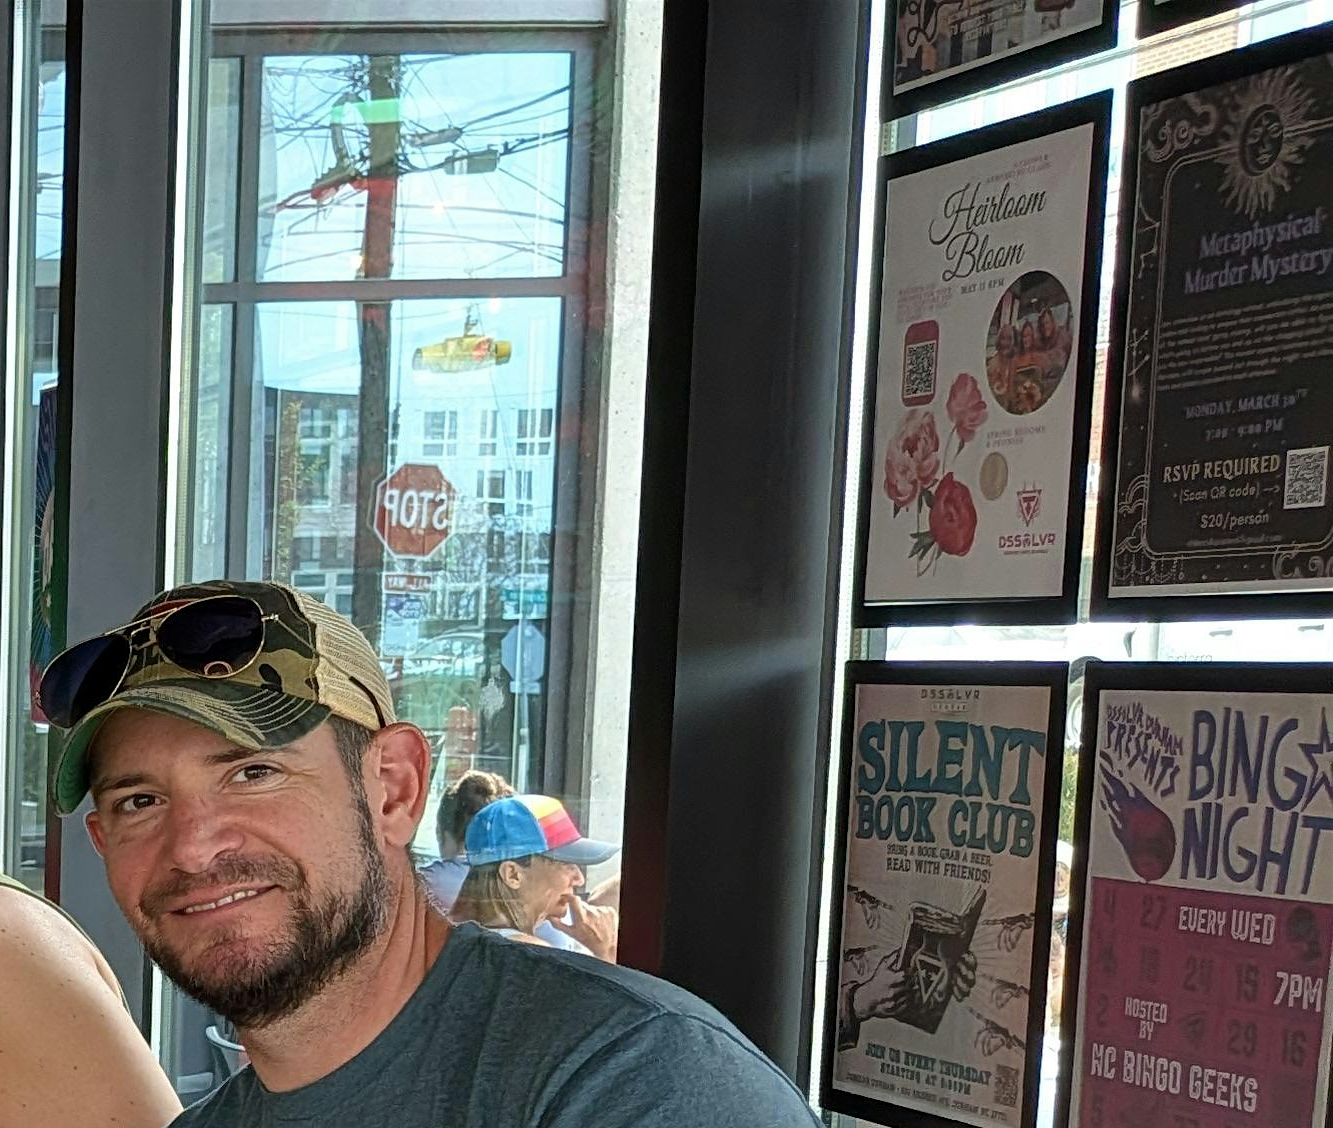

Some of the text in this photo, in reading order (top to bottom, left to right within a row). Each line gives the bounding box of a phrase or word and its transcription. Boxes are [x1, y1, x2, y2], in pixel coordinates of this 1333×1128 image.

[928, 182, 1046, 245] Heirloom
[1199, 207, 1321, 259] Metaphysical
[942, 229, 1026, 282] Bloom
[1184, 247, 1333, 295] Murder Mystery
[1163, 454, 1281, 483] RSVP REQUIRED
[1200, 511, 1269, 530] $20/person
[858, 719, 1046, 805] SILENT
[1107, 720, 1180, 797] PRESENTS
[855, 795, 1035, 858] BOOK CLUB
[887, 857, 992, 883] READ WITH FRIENDS!
[940, 848, 961, 862] GRAB
[1180, 808, 1333, 896] NIGHT
[1178, 905, 1276, 946] EVERY WED
[1124, 996, 1168, 1024] HOSTED
[1273, 971, 1323, 1013] 7PM
[1138, 1022, 1154, 1041] BY
[939, 1059, 992, 1086] THURSDAY
[1090, 1043, 1259, 1113] NC BINGO GEEKS
